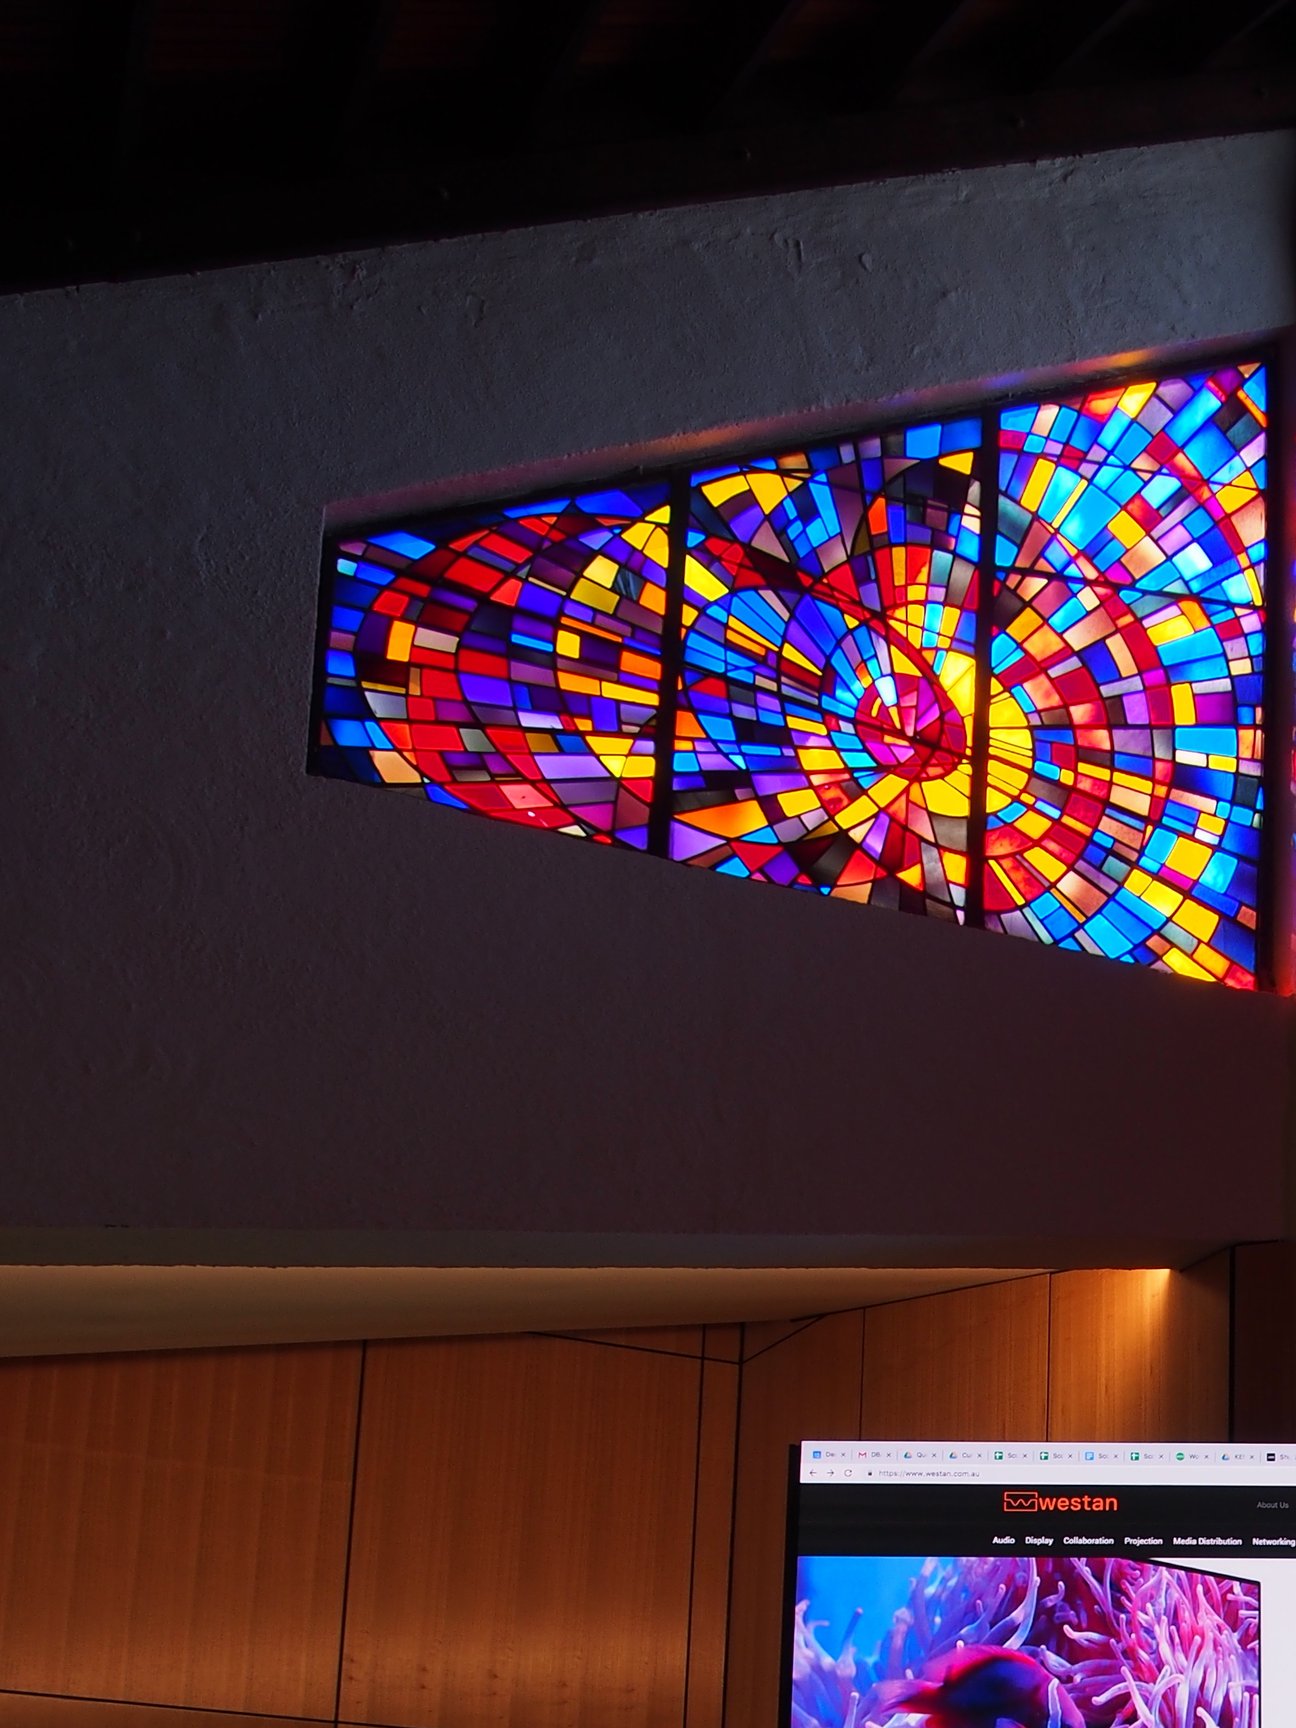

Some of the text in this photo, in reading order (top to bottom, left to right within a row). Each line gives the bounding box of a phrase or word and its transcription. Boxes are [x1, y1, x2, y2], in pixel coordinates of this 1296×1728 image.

[1039, 1495, 1118, 1512] westan
[1256, 1501, 1289, 1509] About Us
[992, 1536, 1015, 1545] Audio
[1025, 1536, 1054, 1546] Display
[1063, 1536, 1115, 1546] Collaboration
[1124, 1536, 1163, 1547] Projection
[1173, 1537, 1197, 1546] Media
[1198, 1537, 1243, 1547] Distribution
[1252, 1537, 1296, 1548] Networking
